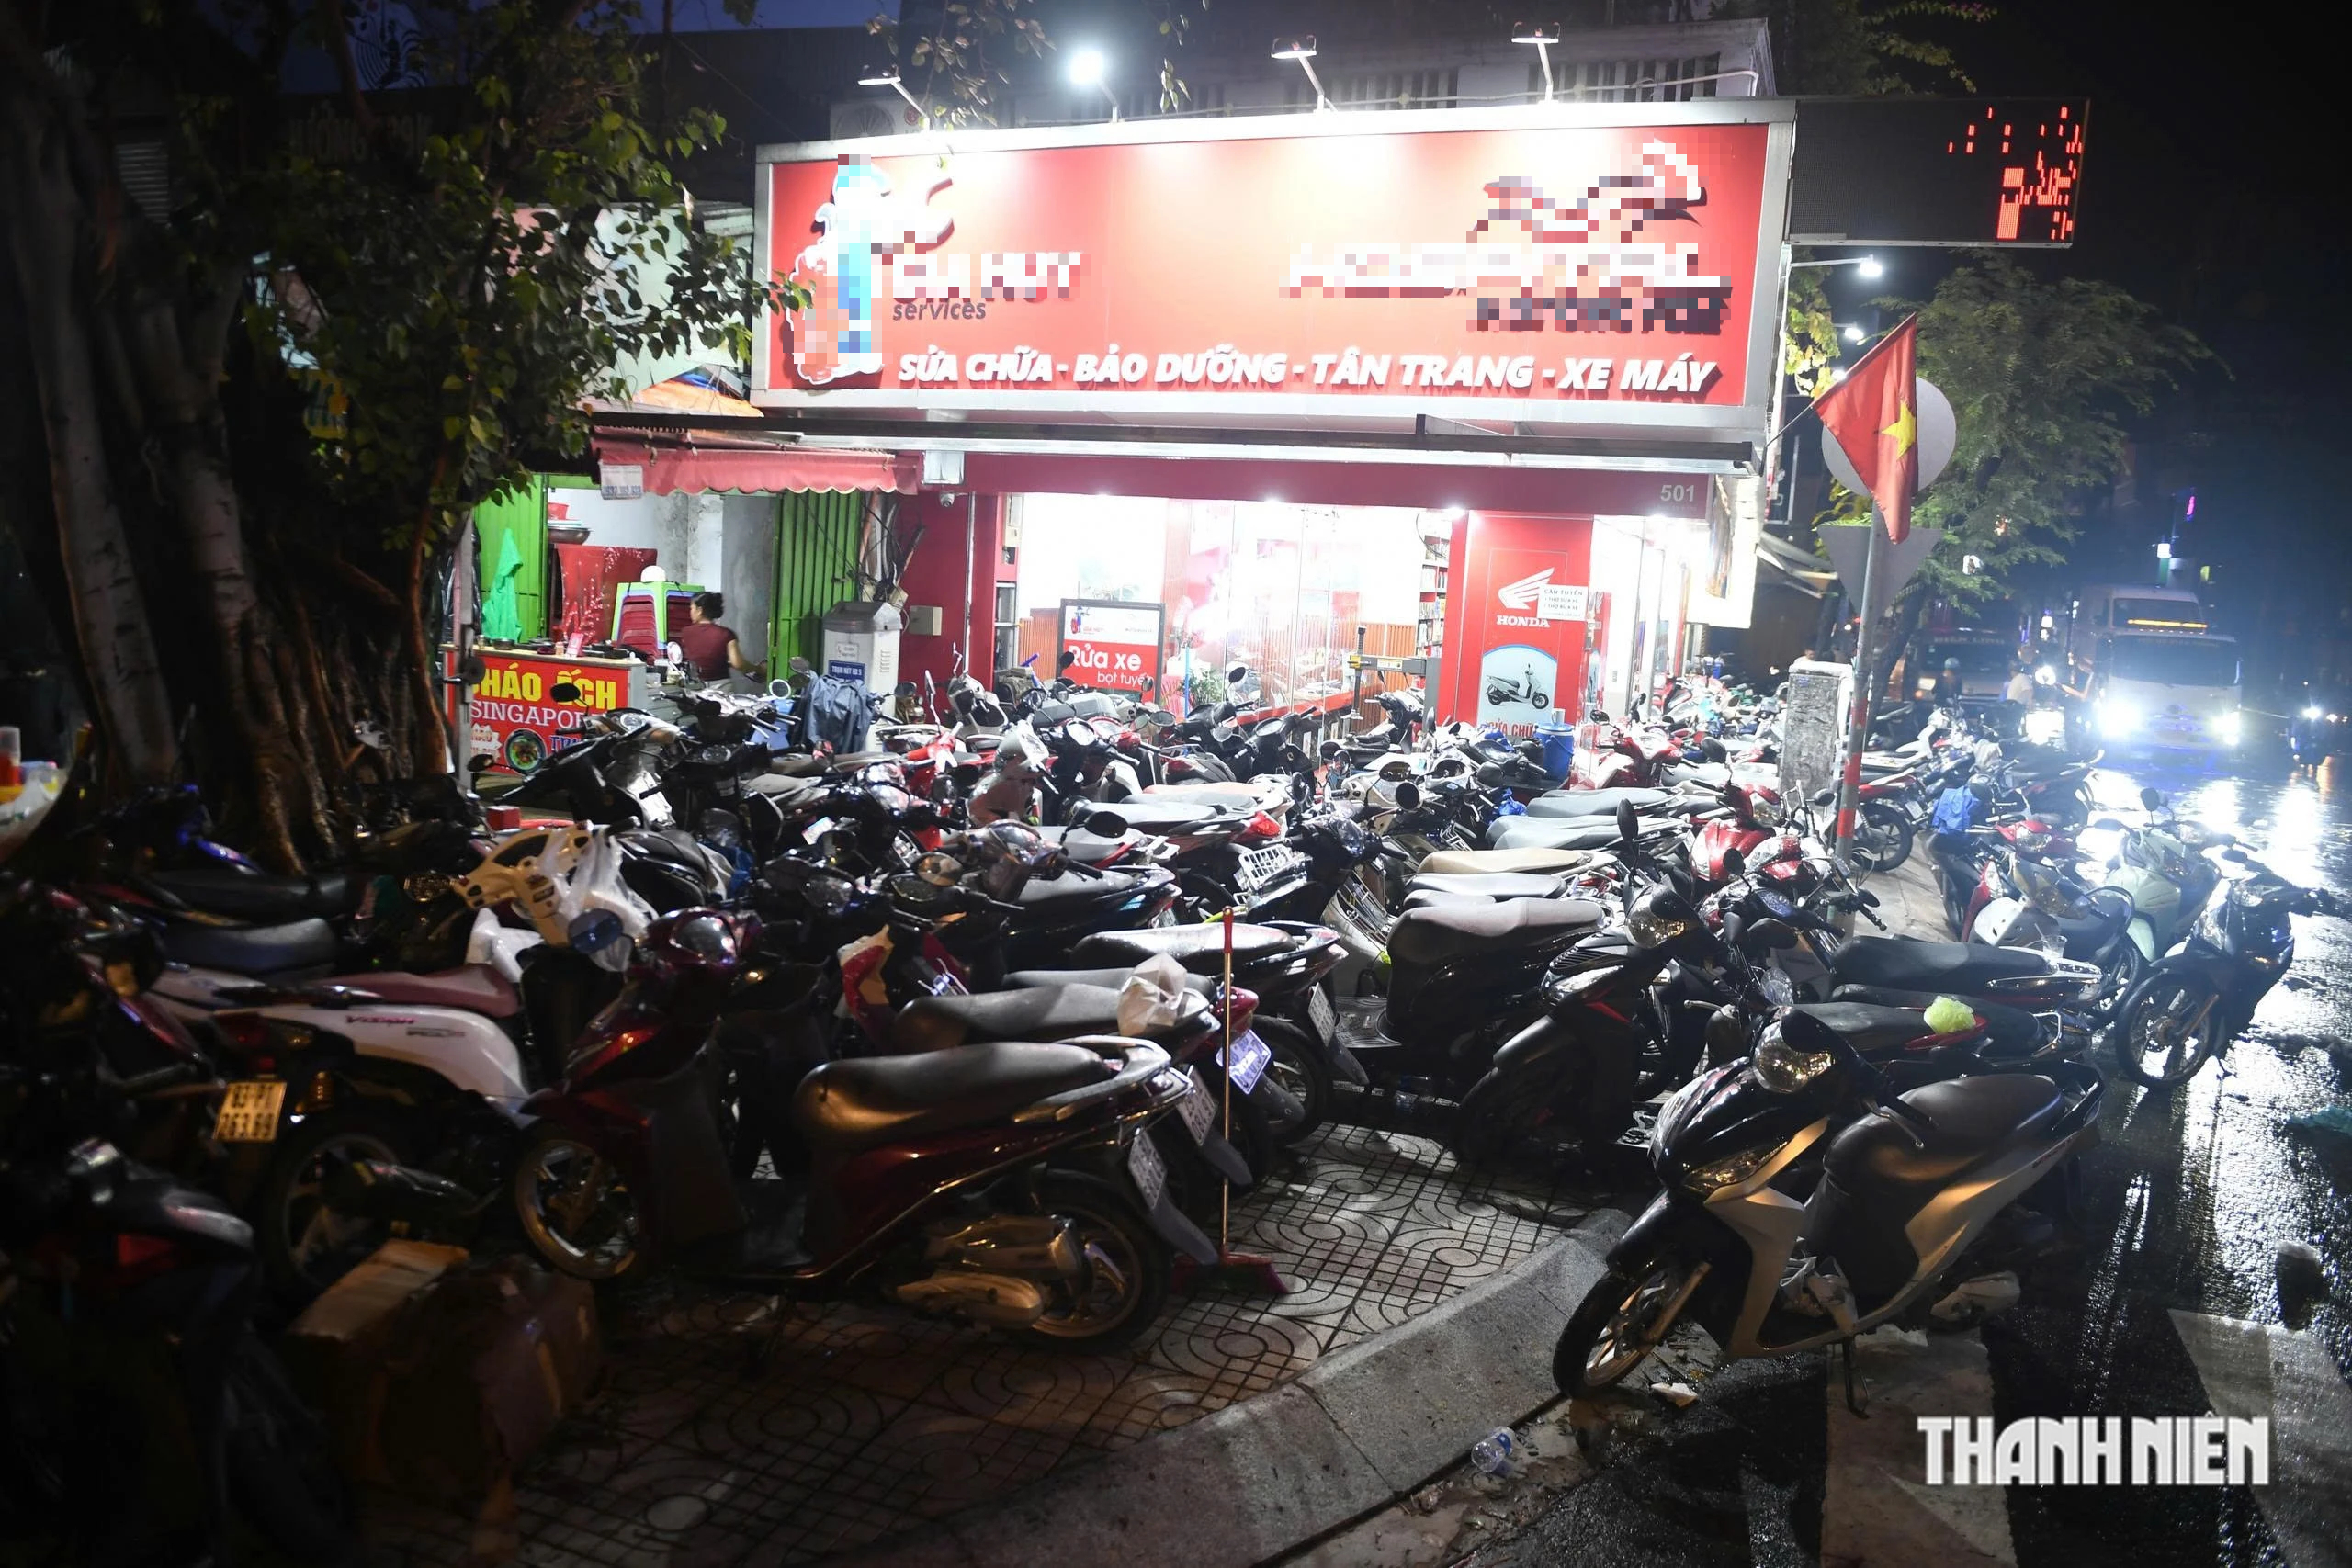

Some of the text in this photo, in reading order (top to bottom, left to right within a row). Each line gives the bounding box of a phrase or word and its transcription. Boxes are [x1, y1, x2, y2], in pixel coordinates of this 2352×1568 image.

[892, 301, 987, 321] services
[898, 344, 958, 382] SỬA
[966, 345, 1053, 382] CHỮA
[1073, 343, 1148, 383] BẢO
[1153, 343, 1287, 384] DƯỠNG
[1311, 345, 1393, 386] TÂN
[1400, 354, 1536, 388] TRANG
[1557, 357, 1613, 389] XE
[1620, 352, 1718, 392] MÁY
[1660, 484, 1695, 502] 501
[1496, 615, 1551, 628] HONDA
[1069, 642, 1142, 671] Rửa xe
[472, 662, 542, 703] HÁO
[1097, 671, 1118, 686] bọt
[470, 699, 602, 729] SINGAPO
[1511, 722, 1534, 739] CHỮ
